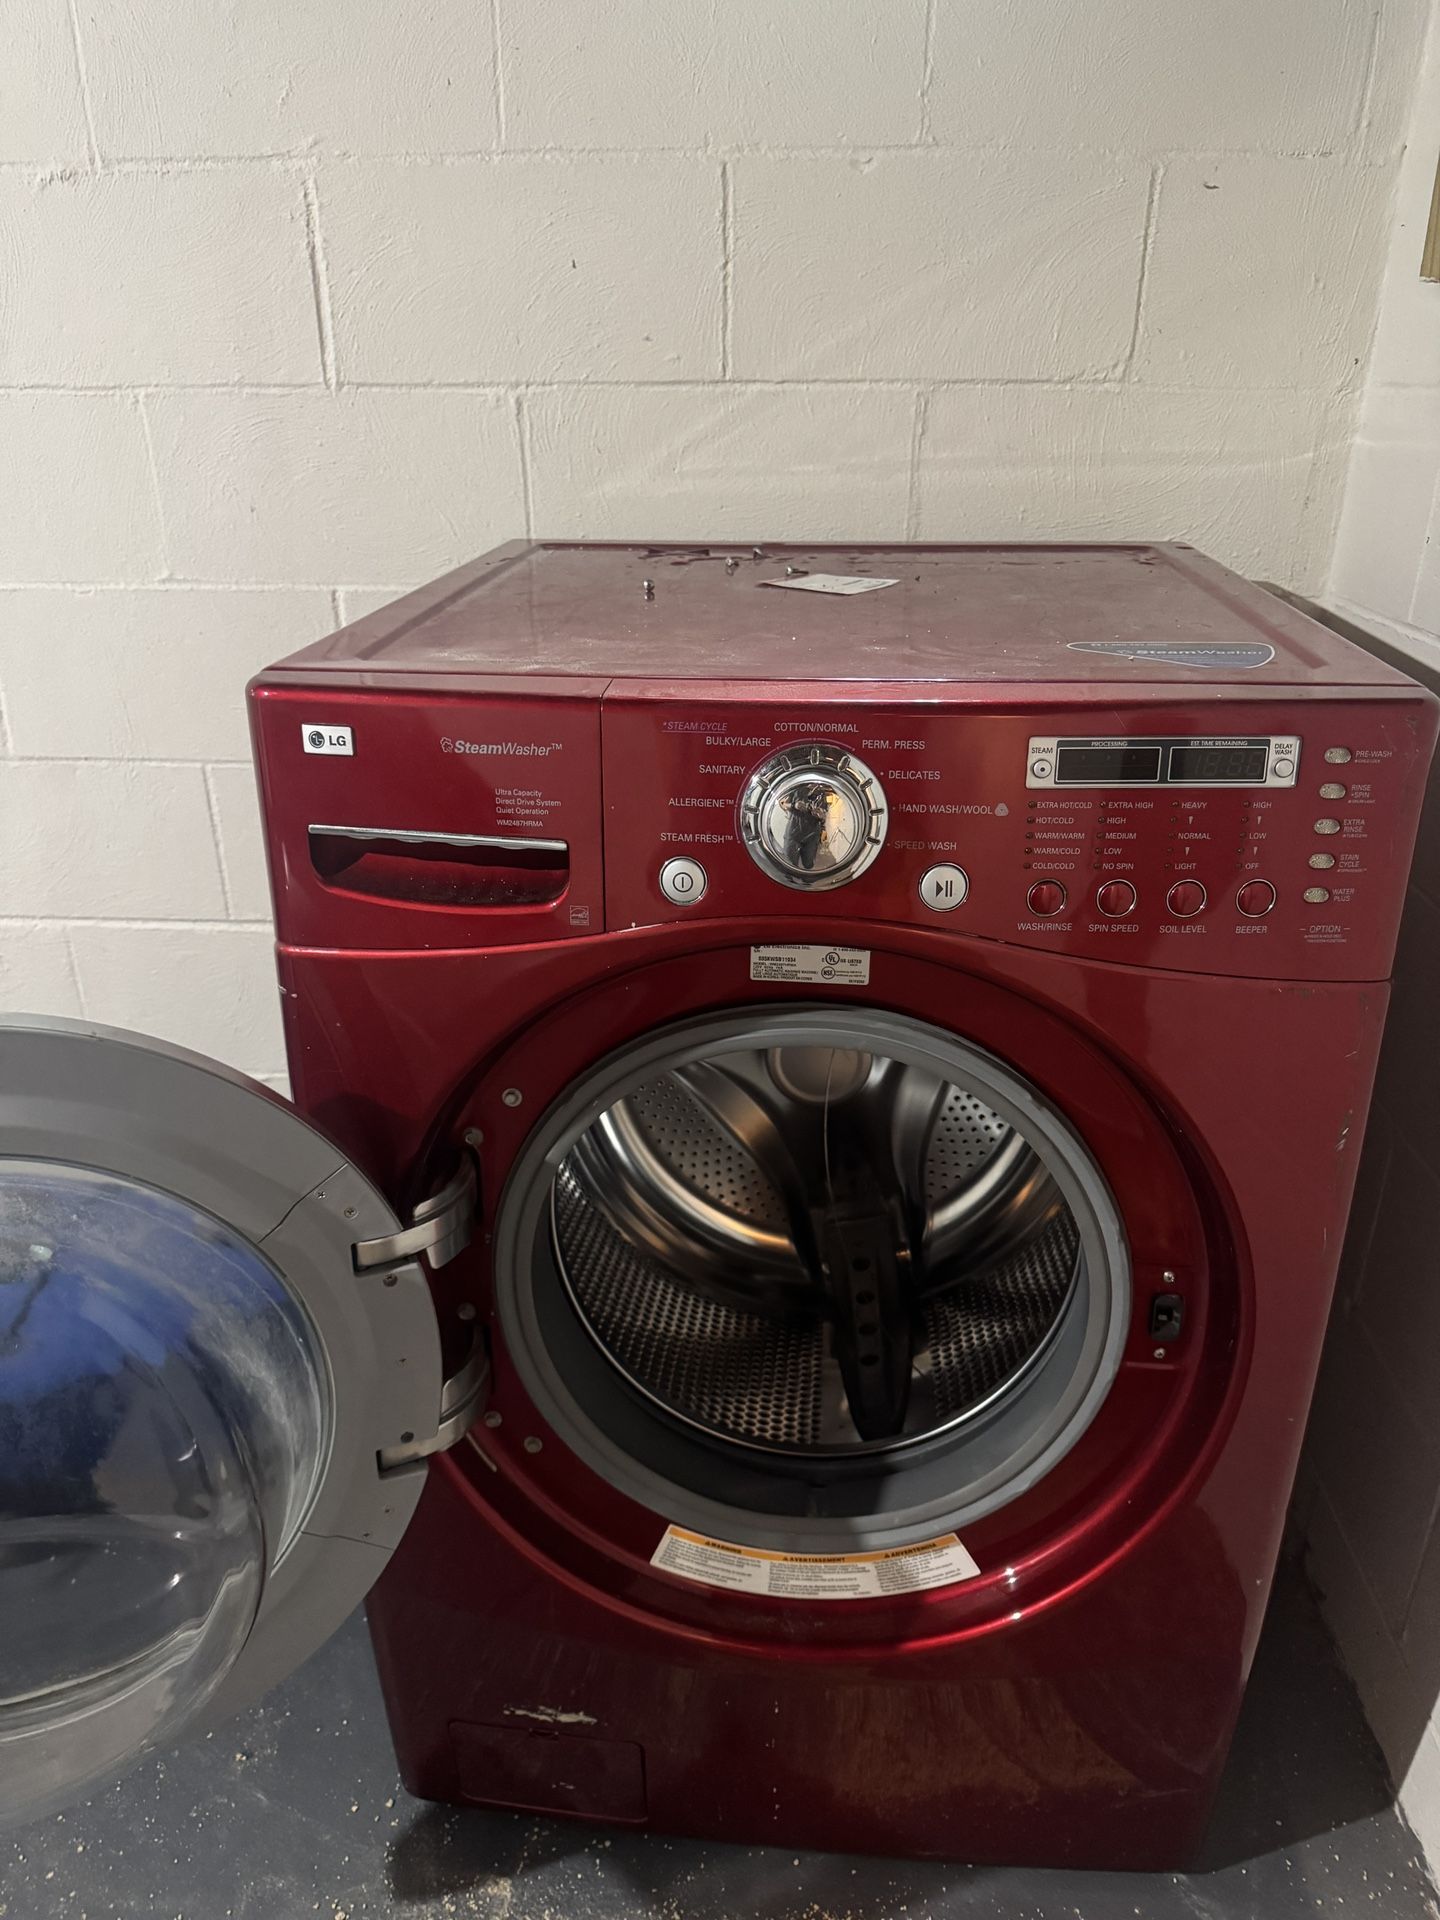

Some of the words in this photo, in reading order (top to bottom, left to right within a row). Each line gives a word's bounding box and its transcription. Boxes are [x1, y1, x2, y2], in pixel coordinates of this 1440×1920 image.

[700, 722, 727, 731] CYCLE
[773, 722, 859, 733] COTTON/NORMAL
[328, 735, 347, 747] LG
[705, 736, 771, 747] BULKY/LARGE
[862, 739, 892, 749] PERM.
[894, 740, 925, 750] PRESS
[1355, 750, 1392, 758] PRE-WASH
[699, 765, 746, 775] SANITARY
[888, 770, 941, 780] DELICATES
[495, 788, 512, 796] Ultra
[513, 789, 542, 798] Capacity
[495, 797, 515, 805] Direct
[516, 798, 535, 806] Drive
[536, 799, 561, 807] System
[1036, 801, 1059, 809] EXTRA
[1060, 801, 1093, 809] HOT/COLD
[496, 806, 514, 814] Quiet
[515, 807, 549, 816] Operation
[899, 804, 926, 813] HAND
[929, 804, 993, 815] WASH/WOOL
[1035, 816, 1074, 824] HOT/COLD
[1106, 816, 1127, 824] HIGH
[1343, 818, 1365, 826] EXTRA
[660, 832, 693, 842] STEAM
[1034, 832, 1085, 840] WARM/WARM
[1105, 832, 1137, 840] MEDIUM
[1178, 832, 1212, 840] NORMAL
[1249, 832, 1267, 840] LOW
[894, 840, 925, 850] SPEED
[928, 841, 957, 851] WASH
[1033, 847, 1081, 855] WARM/COLD
[1103, 847, 1122, 855] LOW
[1032, 862, 1076, 870] COLD/COLD
[1102, 862, 1115, 870] NO
[1116, 862, 1134, 870] SPIN
[1174, 862, 1197, 870] LIGHT
[1245, 862, 1260, 870] OFF
[1017, 922, 1073, 932] WASH/RINSE
[1088, 924, 1111, 933] SPIN
[1113, 924, 1139, 933] SPEED
[1159, 925, 1180, 934] SOIL
[1181, 925, 1208, 934] LEVEL
[1235, 925, 1268, 934] BEEPER
[1309, 925, 1342, 934] OPTION
